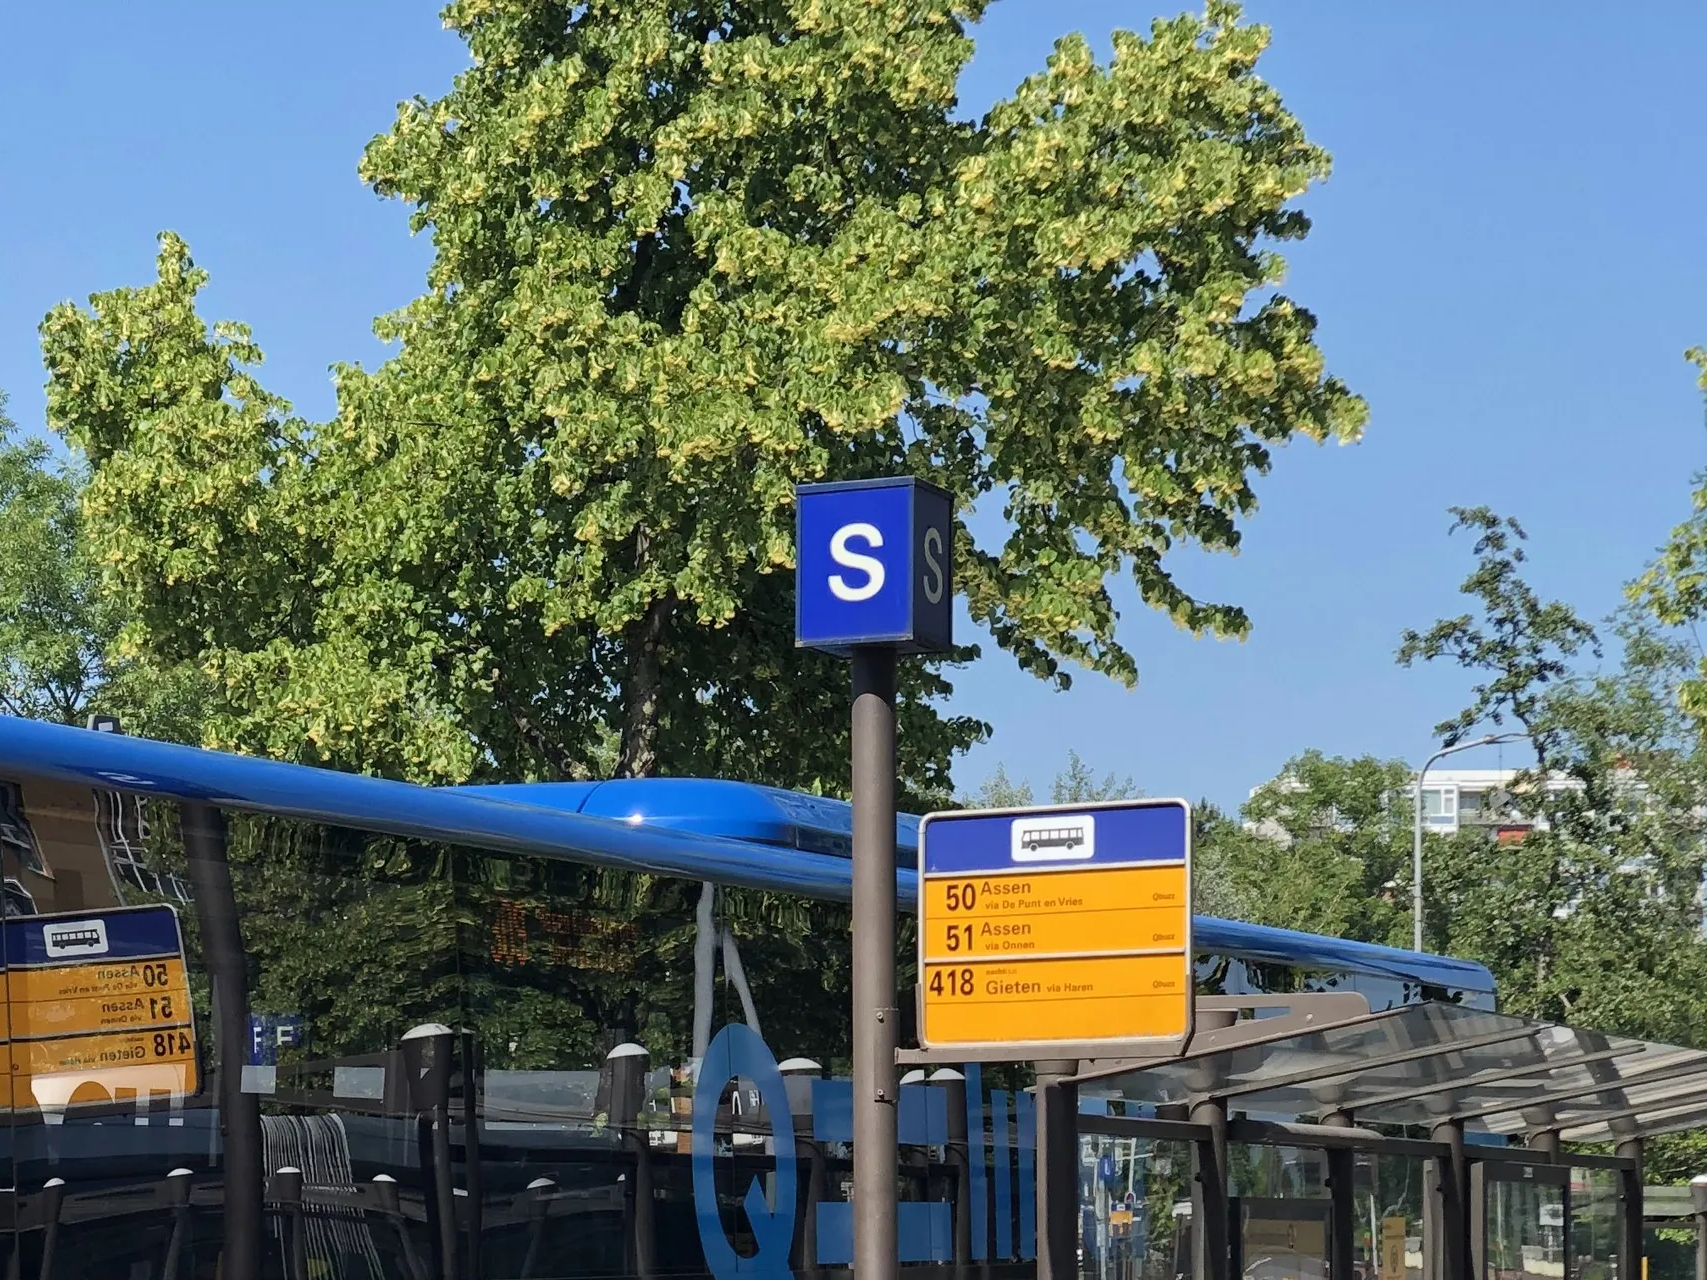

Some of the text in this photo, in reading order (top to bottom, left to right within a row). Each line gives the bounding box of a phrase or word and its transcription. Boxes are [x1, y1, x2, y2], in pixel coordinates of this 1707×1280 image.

[828, 522, 886, 602] S
[923, 527, 944, 604] S
[946, 881, 1031, 911] 50 Assen
[985, 897, 1083, 909] via De Punt en Vries
[946, 921, 1031, 951] 51 Assen
[985, 941, 1035, 950] via Onnen
[930, 968, 1093, 997] 418 Gieten via Haren
